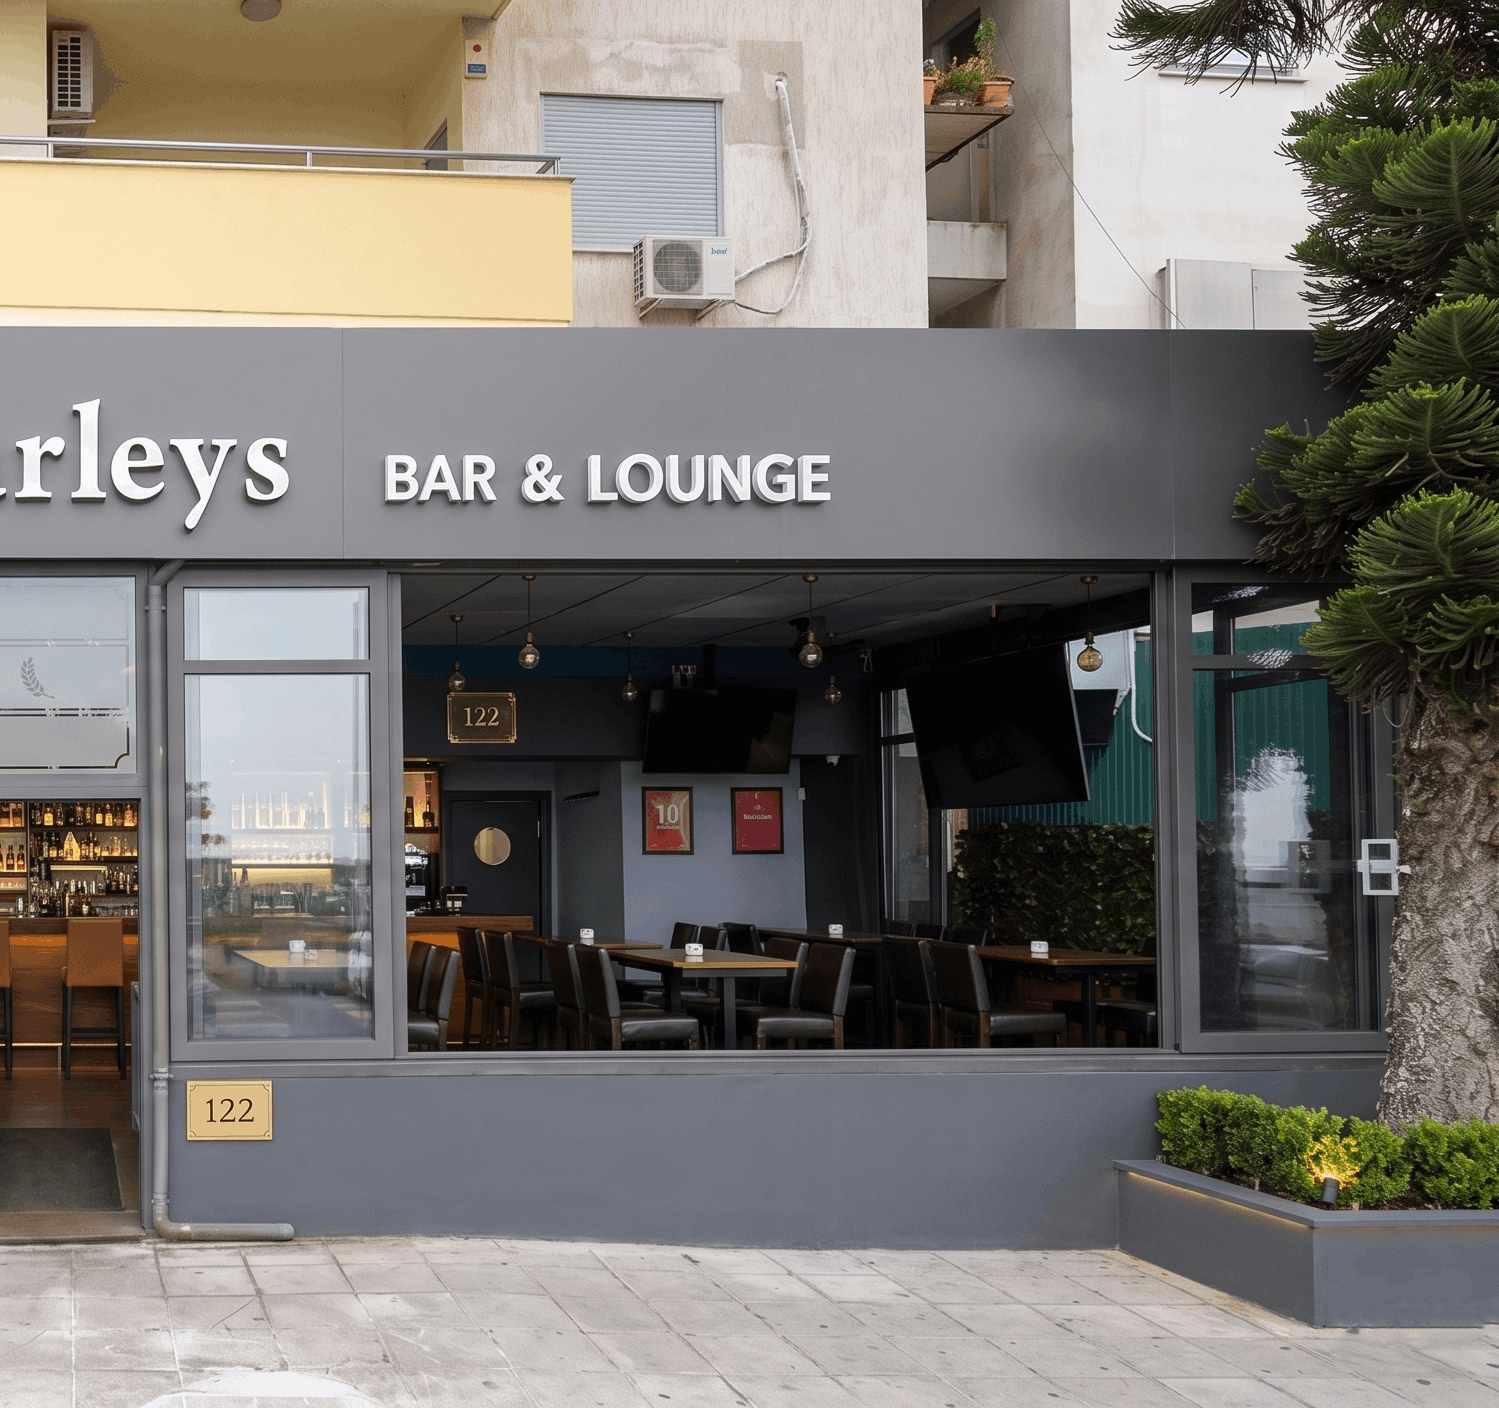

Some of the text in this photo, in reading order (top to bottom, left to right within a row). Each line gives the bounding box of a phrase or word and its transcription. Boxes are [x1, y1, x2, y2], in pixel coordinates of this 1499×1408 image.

[384, 452, 832, 504] BAR & LOUNGE
[463, 706, 500, 727] 122
[655, 803, 680, 825] 10
[205, 1098, 255, 1123] 122
